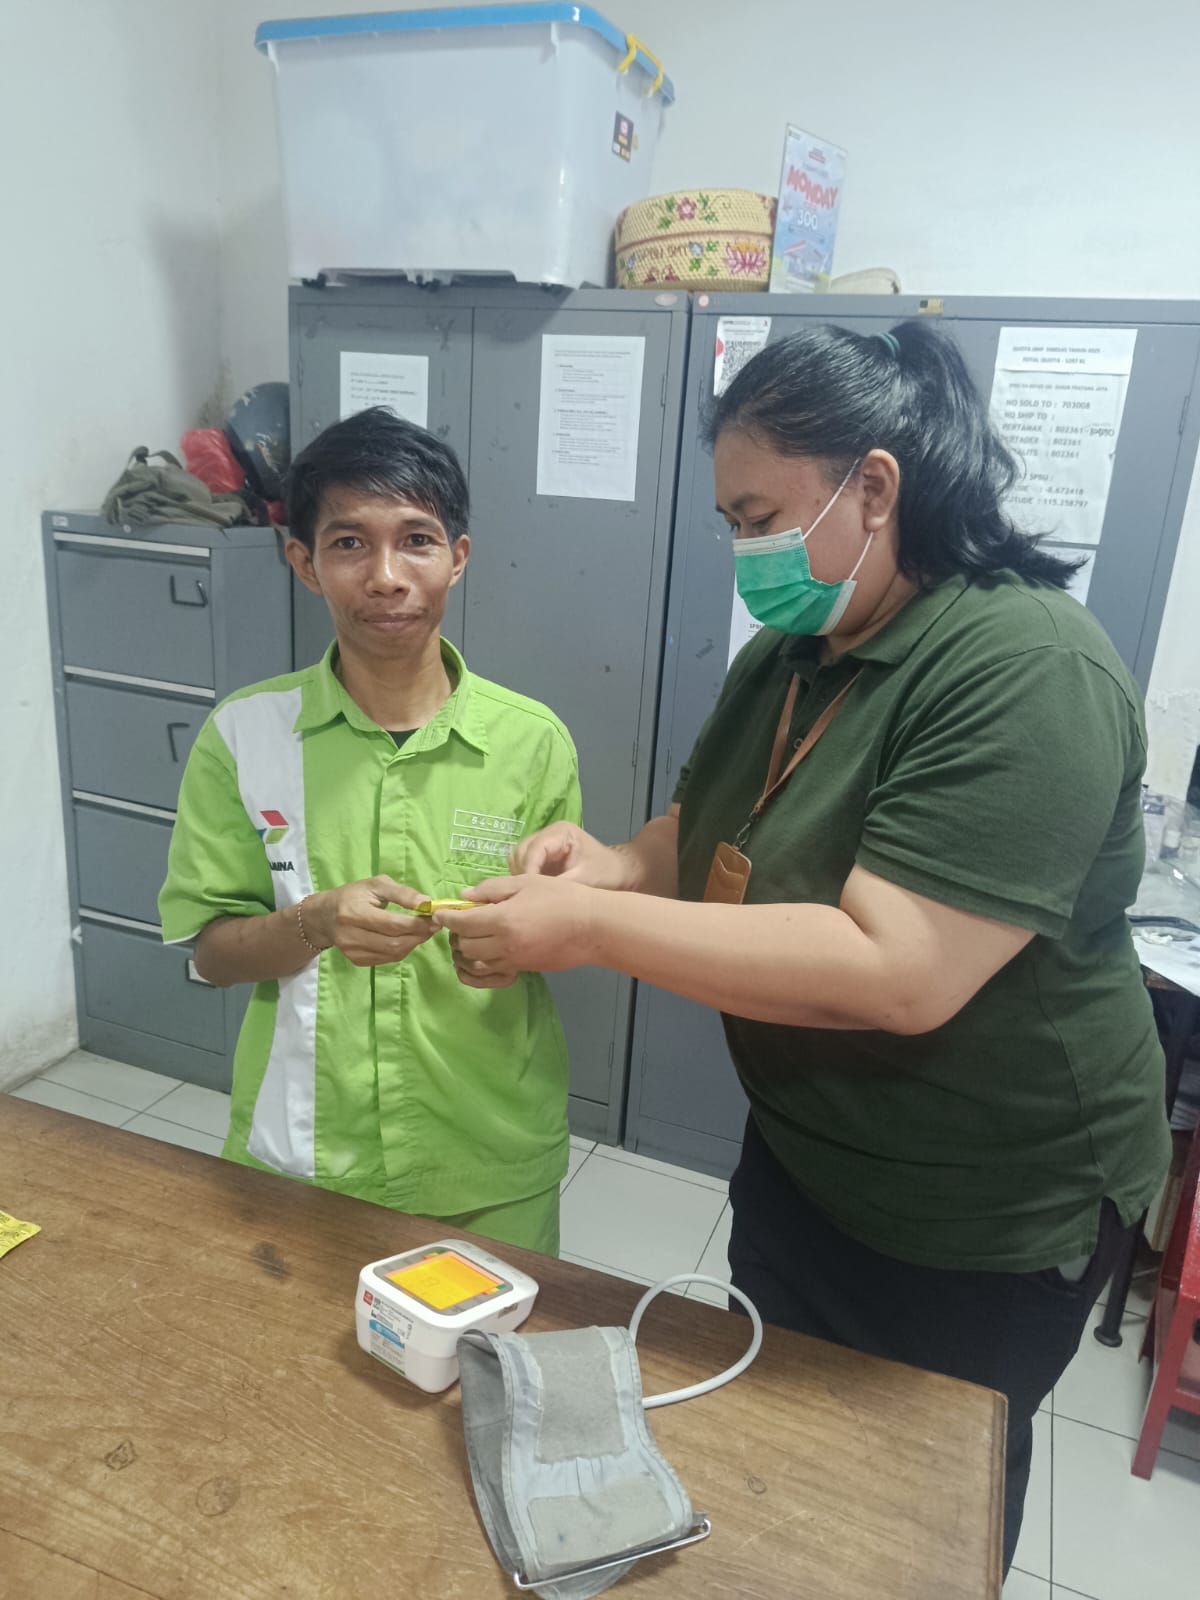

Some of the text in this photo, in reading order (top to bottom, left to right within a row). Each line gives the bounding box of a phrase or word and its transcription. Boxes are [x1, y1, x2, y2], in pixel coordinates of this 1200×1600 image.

[787, 164, 838, 208] MONDAY
[797, 209, 817, 230] 300
[1020, 400, 1040, 408] SOLD
